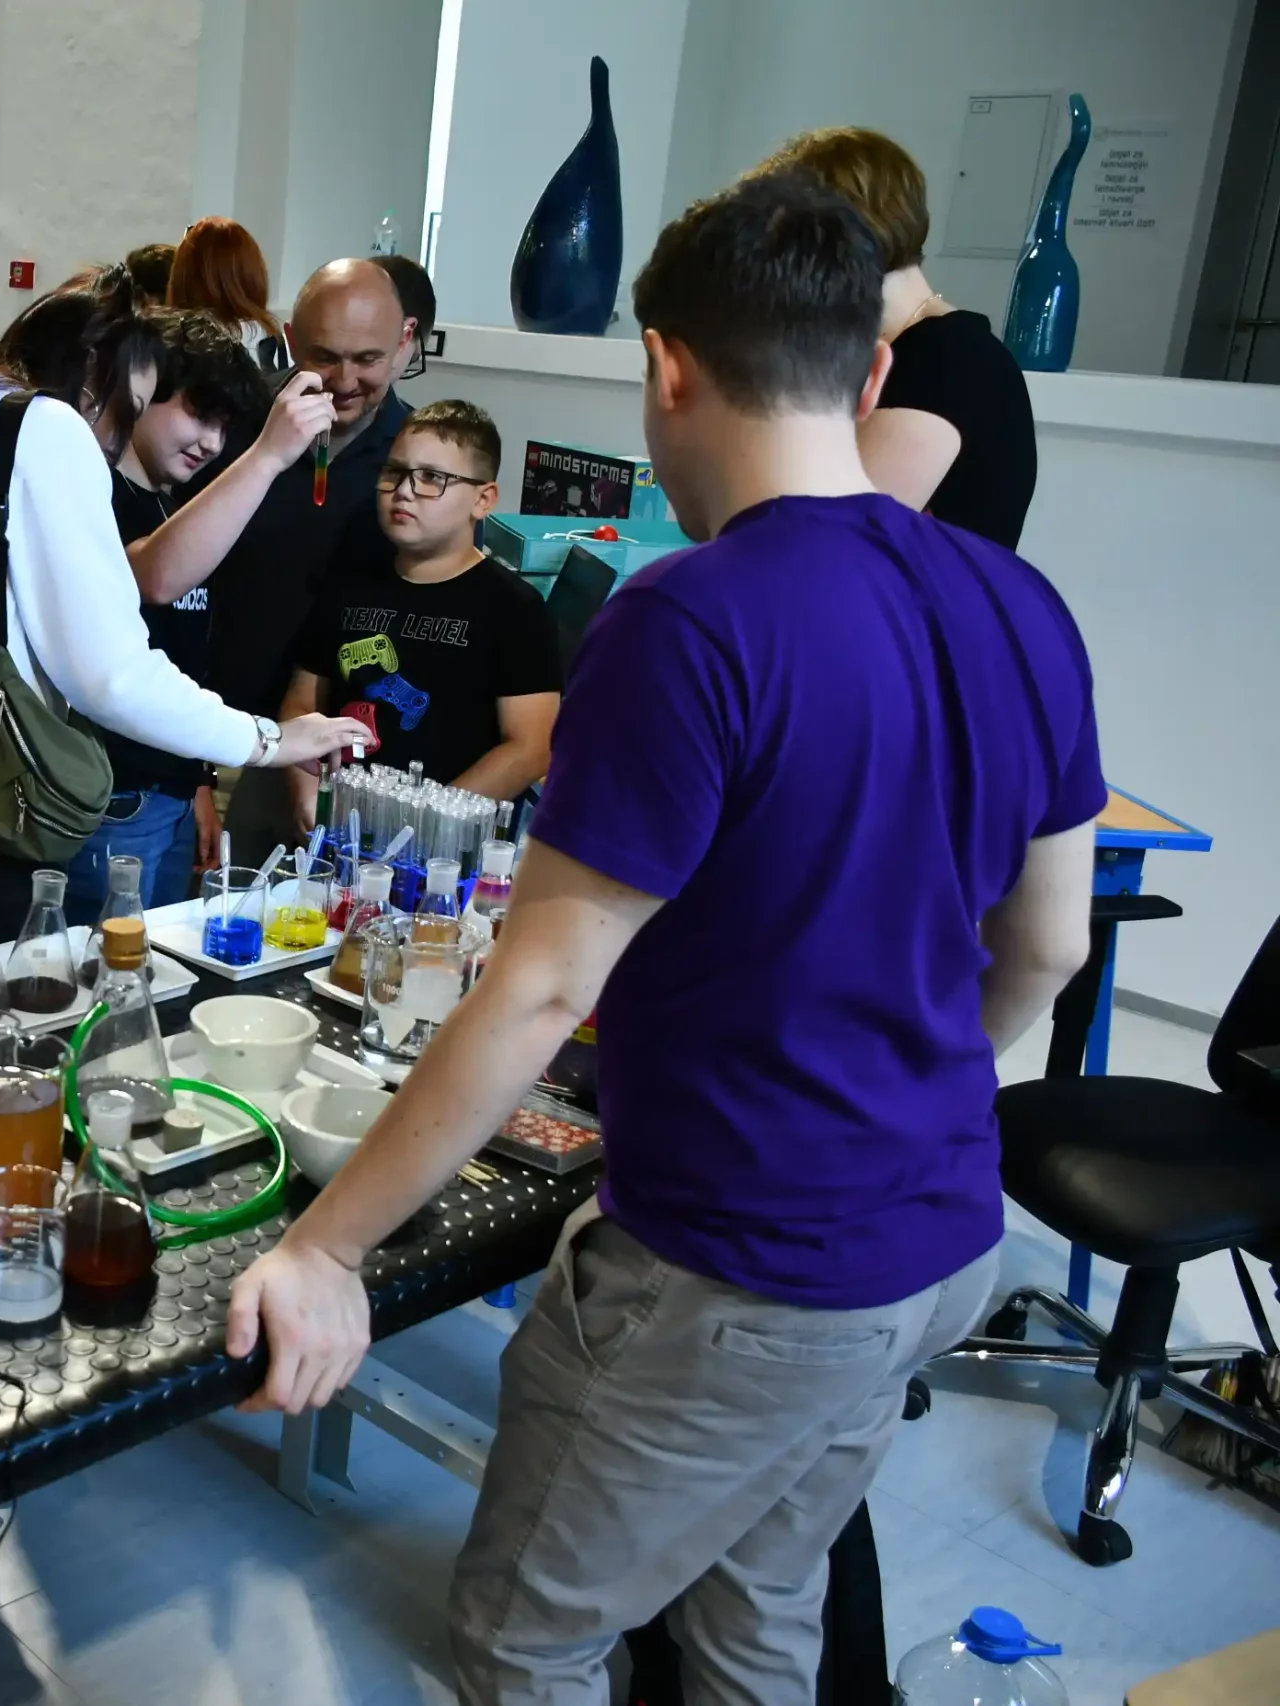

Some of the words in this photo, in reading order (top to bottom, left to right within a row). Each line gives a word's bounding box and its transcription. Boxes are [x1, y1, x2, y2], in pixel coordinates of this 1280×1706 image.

[173, 586, 208, 611] idas
[341, 606, 397, 634] NEXT
[401, 613, 469, 647] LEVEL
